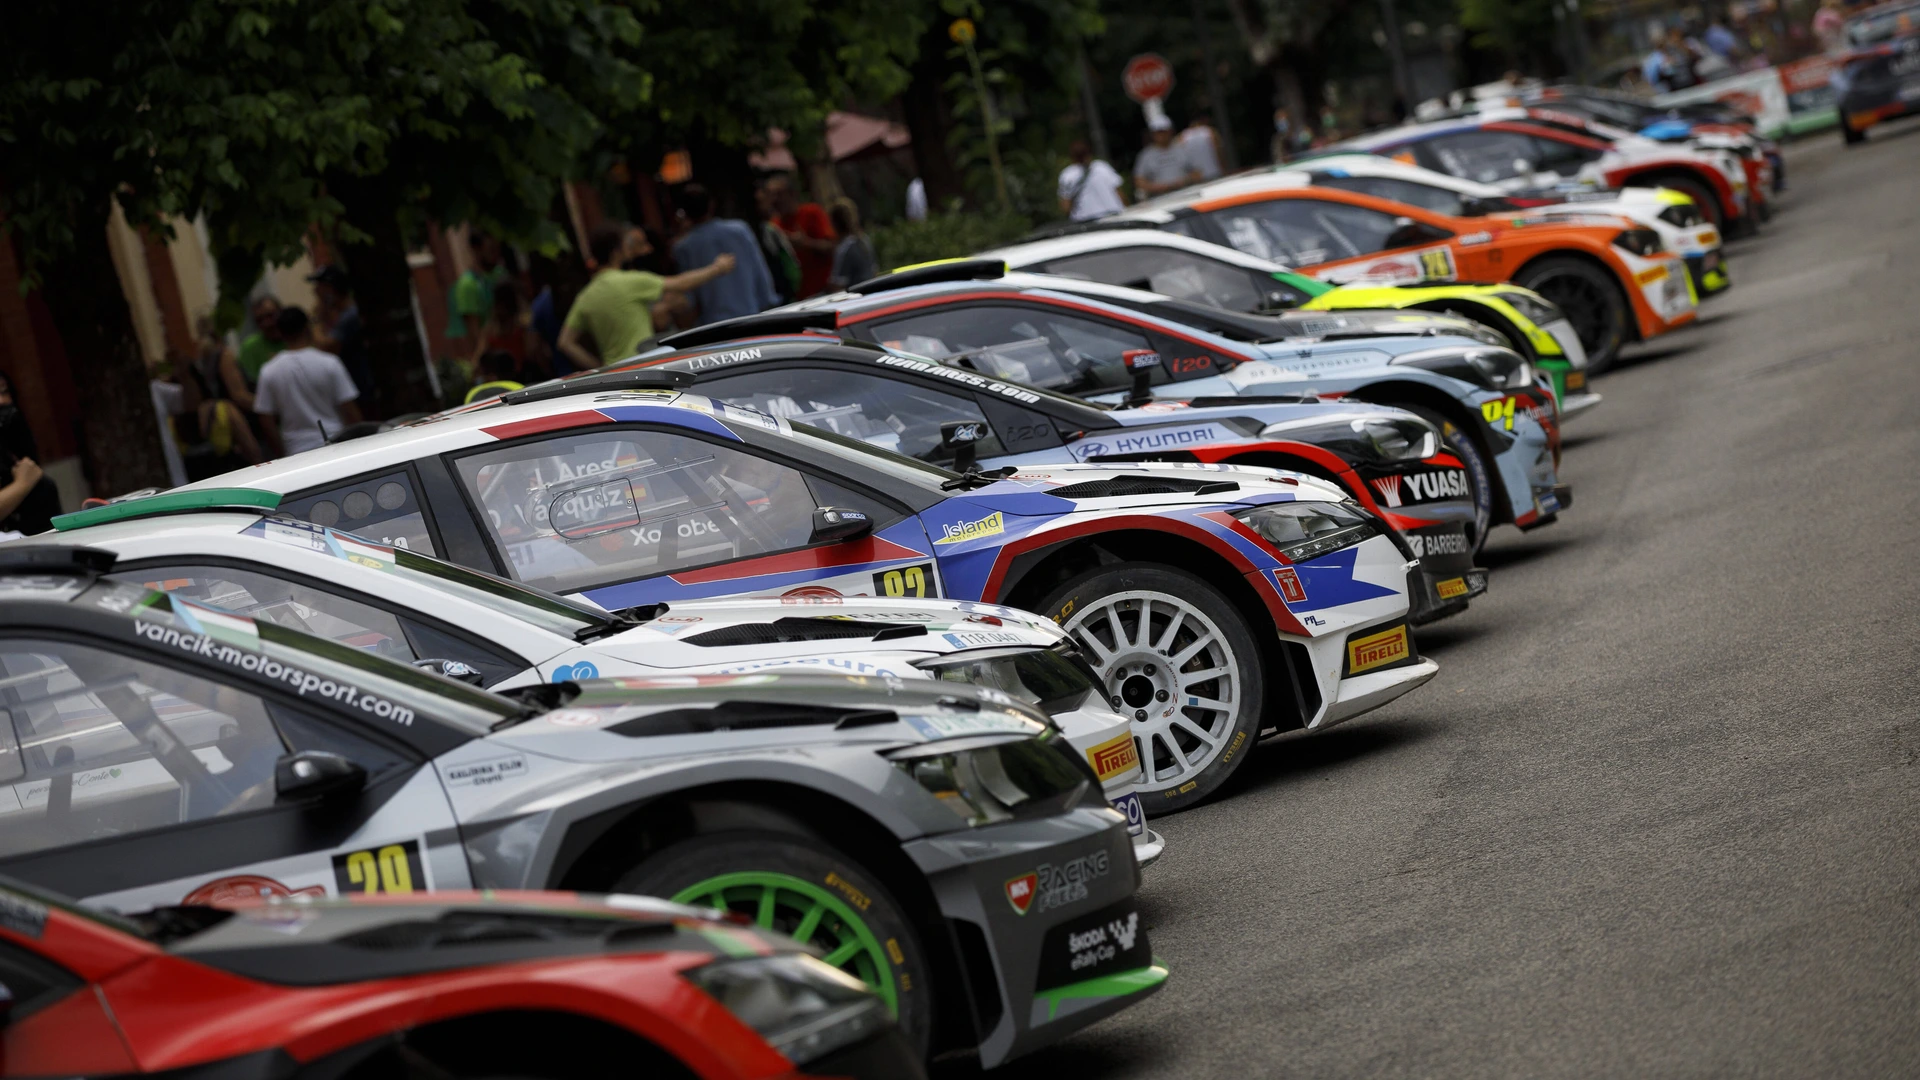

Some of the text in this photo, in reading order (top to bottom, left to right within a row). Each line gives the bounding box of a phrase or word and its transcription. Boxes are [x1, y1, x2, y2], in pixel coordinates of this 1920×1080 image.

[688, 348, 762, 370] LUXEVAN
[1173, 355, 1211, 373] i20
[1116, 428, 1215, 453] HYUNDAI
[1403, 469, 1469, 500] YUASA
[942, 514, 1000, 539] Island
[948, 526, 1001, 543] motorsport
[1354, 632, 1404, 667] PIRELLI
[134, 619, 416, 728] vancik-motorsport.com
